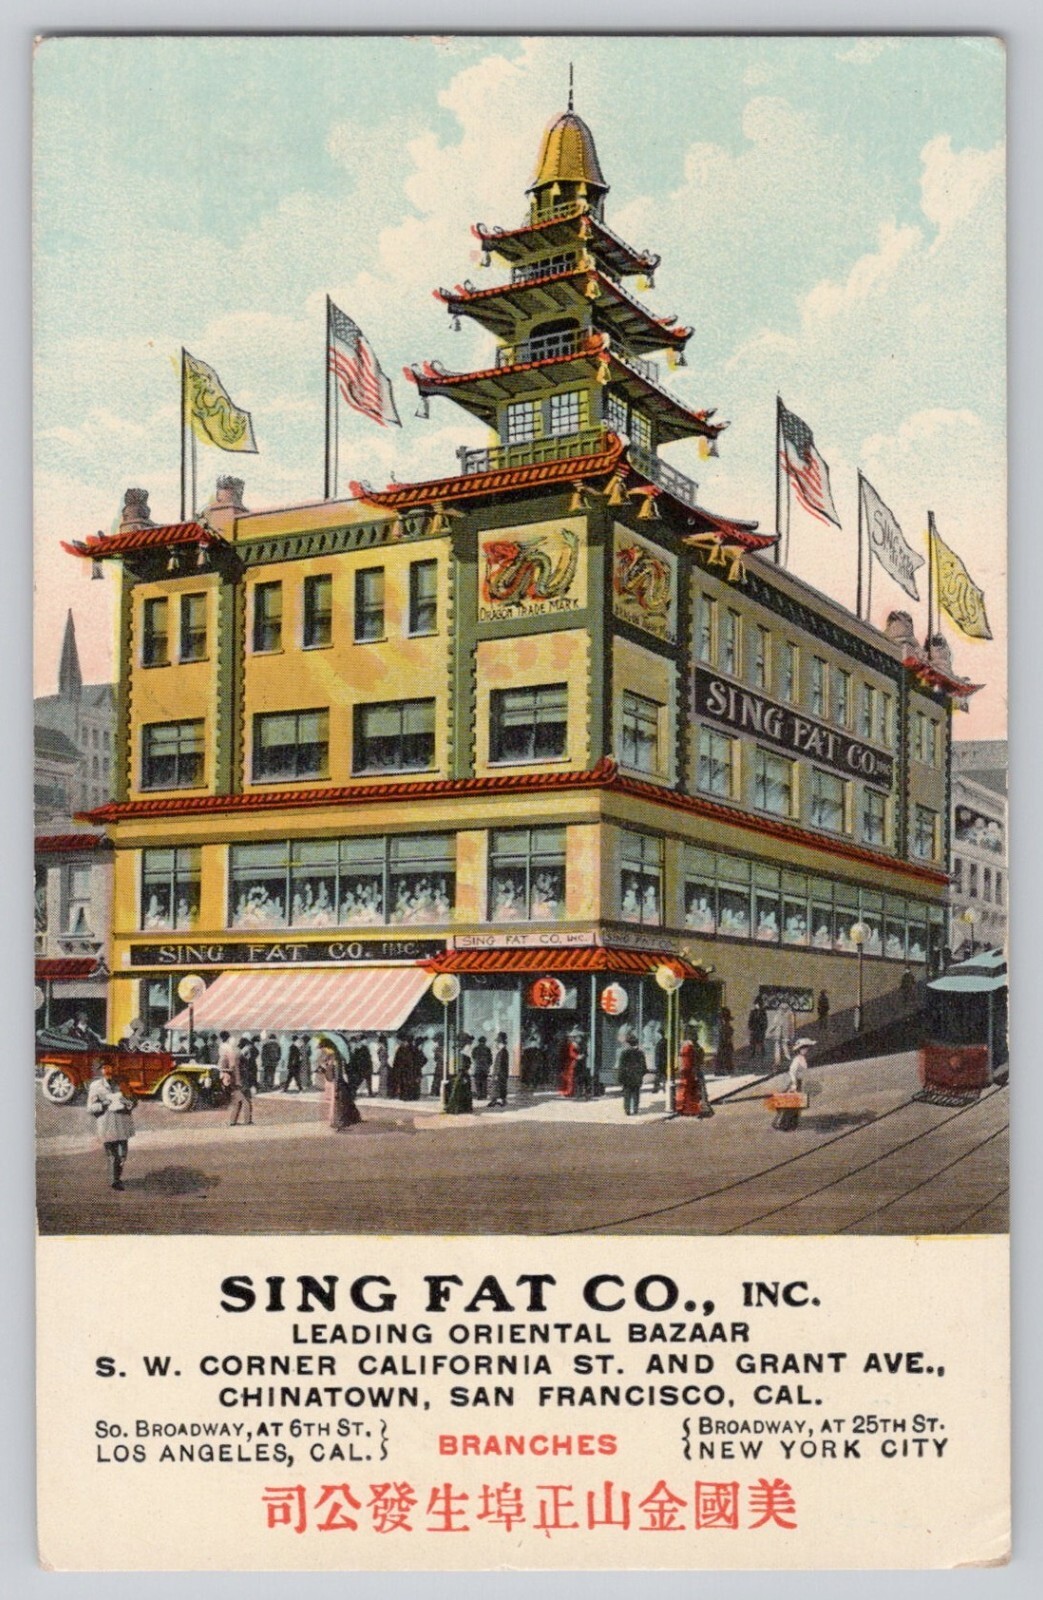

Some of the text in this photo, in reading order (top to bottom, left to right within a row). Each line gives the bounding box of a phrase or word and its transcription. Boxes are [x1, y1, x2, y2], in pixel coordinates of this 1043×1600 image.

[517, 603, 546, 616] TRADE
[549, 598, 579, 612] MARK
[706, 680, 784, 740] SING
[793, 717, 842, 761] FAT
[463, 935, 496, 947] SING
[505, 934, 527, 945] FAT
[540, 933, 562, 945] CO.
[158, 944, 225, 964] SING
[250, 943, 308, 962] FAT
[328, 942, 373, 960] CO.
[219, 1273, 821, 1317] SING FAT CO., INC.
[292, 1321, 750, 1345] LEADING ORIENTAL BAZAAR
[95, 1351, 945, 1378] S. W. CORNER CALIFORNIA ST. AND GRANT AVE.,
[218, 1384, 823, 1411] CHINATOWN, SAN FRANCISCO, CAL.
[256, 1421, 284, 1437] AT
[820, 1418, 846, 1433] AT
[96, 1442, 372, 1467] LOS ANGELES, CAL.
[438, 1434, 618, 1456] BRANCHES
[698, 1437, 949, 1459] NEW YORK CITY
